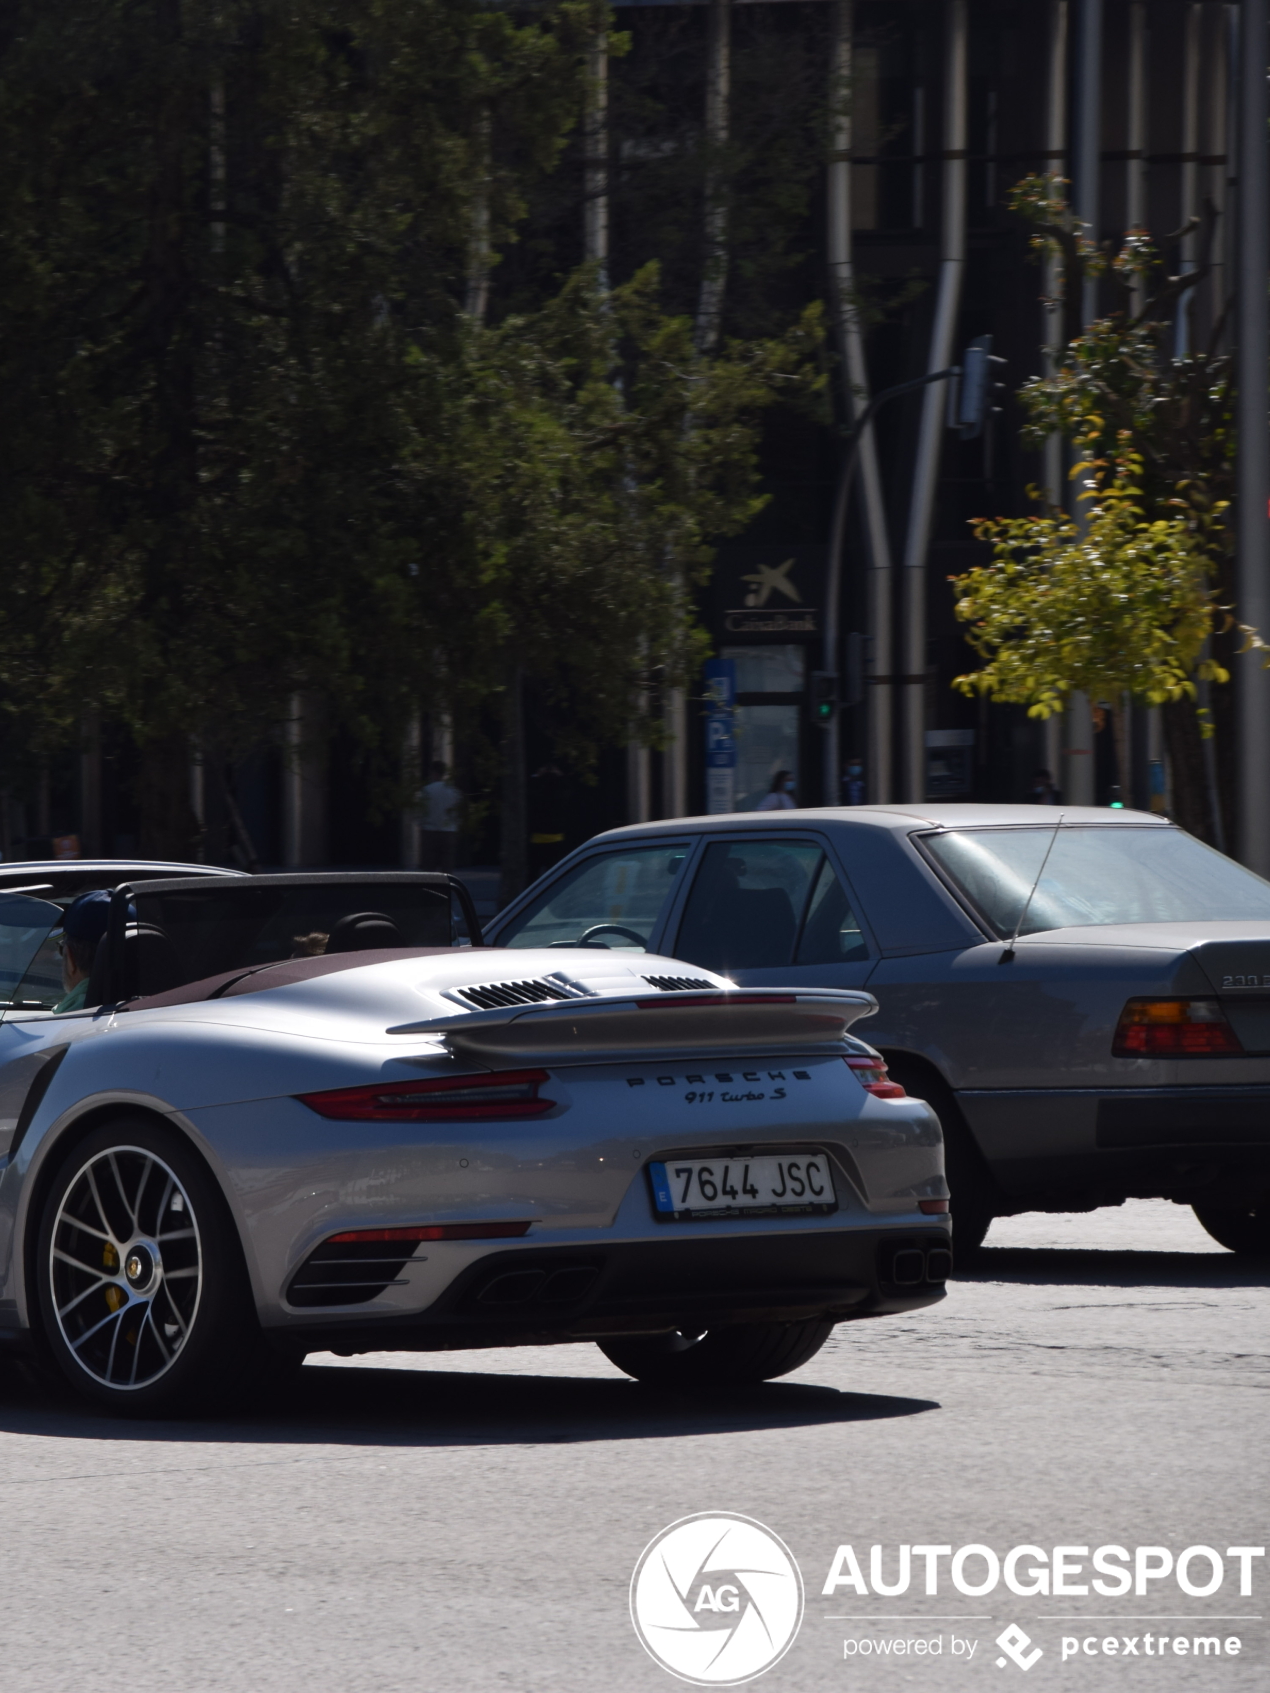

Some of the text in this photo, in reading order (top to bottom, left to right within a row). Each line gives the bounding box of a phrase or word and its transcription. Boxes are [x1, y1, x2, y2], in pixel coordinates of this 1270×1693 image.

[724, 614, 818, 632] CaixaBank
[1222, 975, 1258, 986] 230
[626, 1070, 812, 1088] PORSCHE
[684, 1091, 715, 1104] 911
[770, 1087, 787, 1100] S
[658, 1161, 825, 1204] E 7644 JSC
